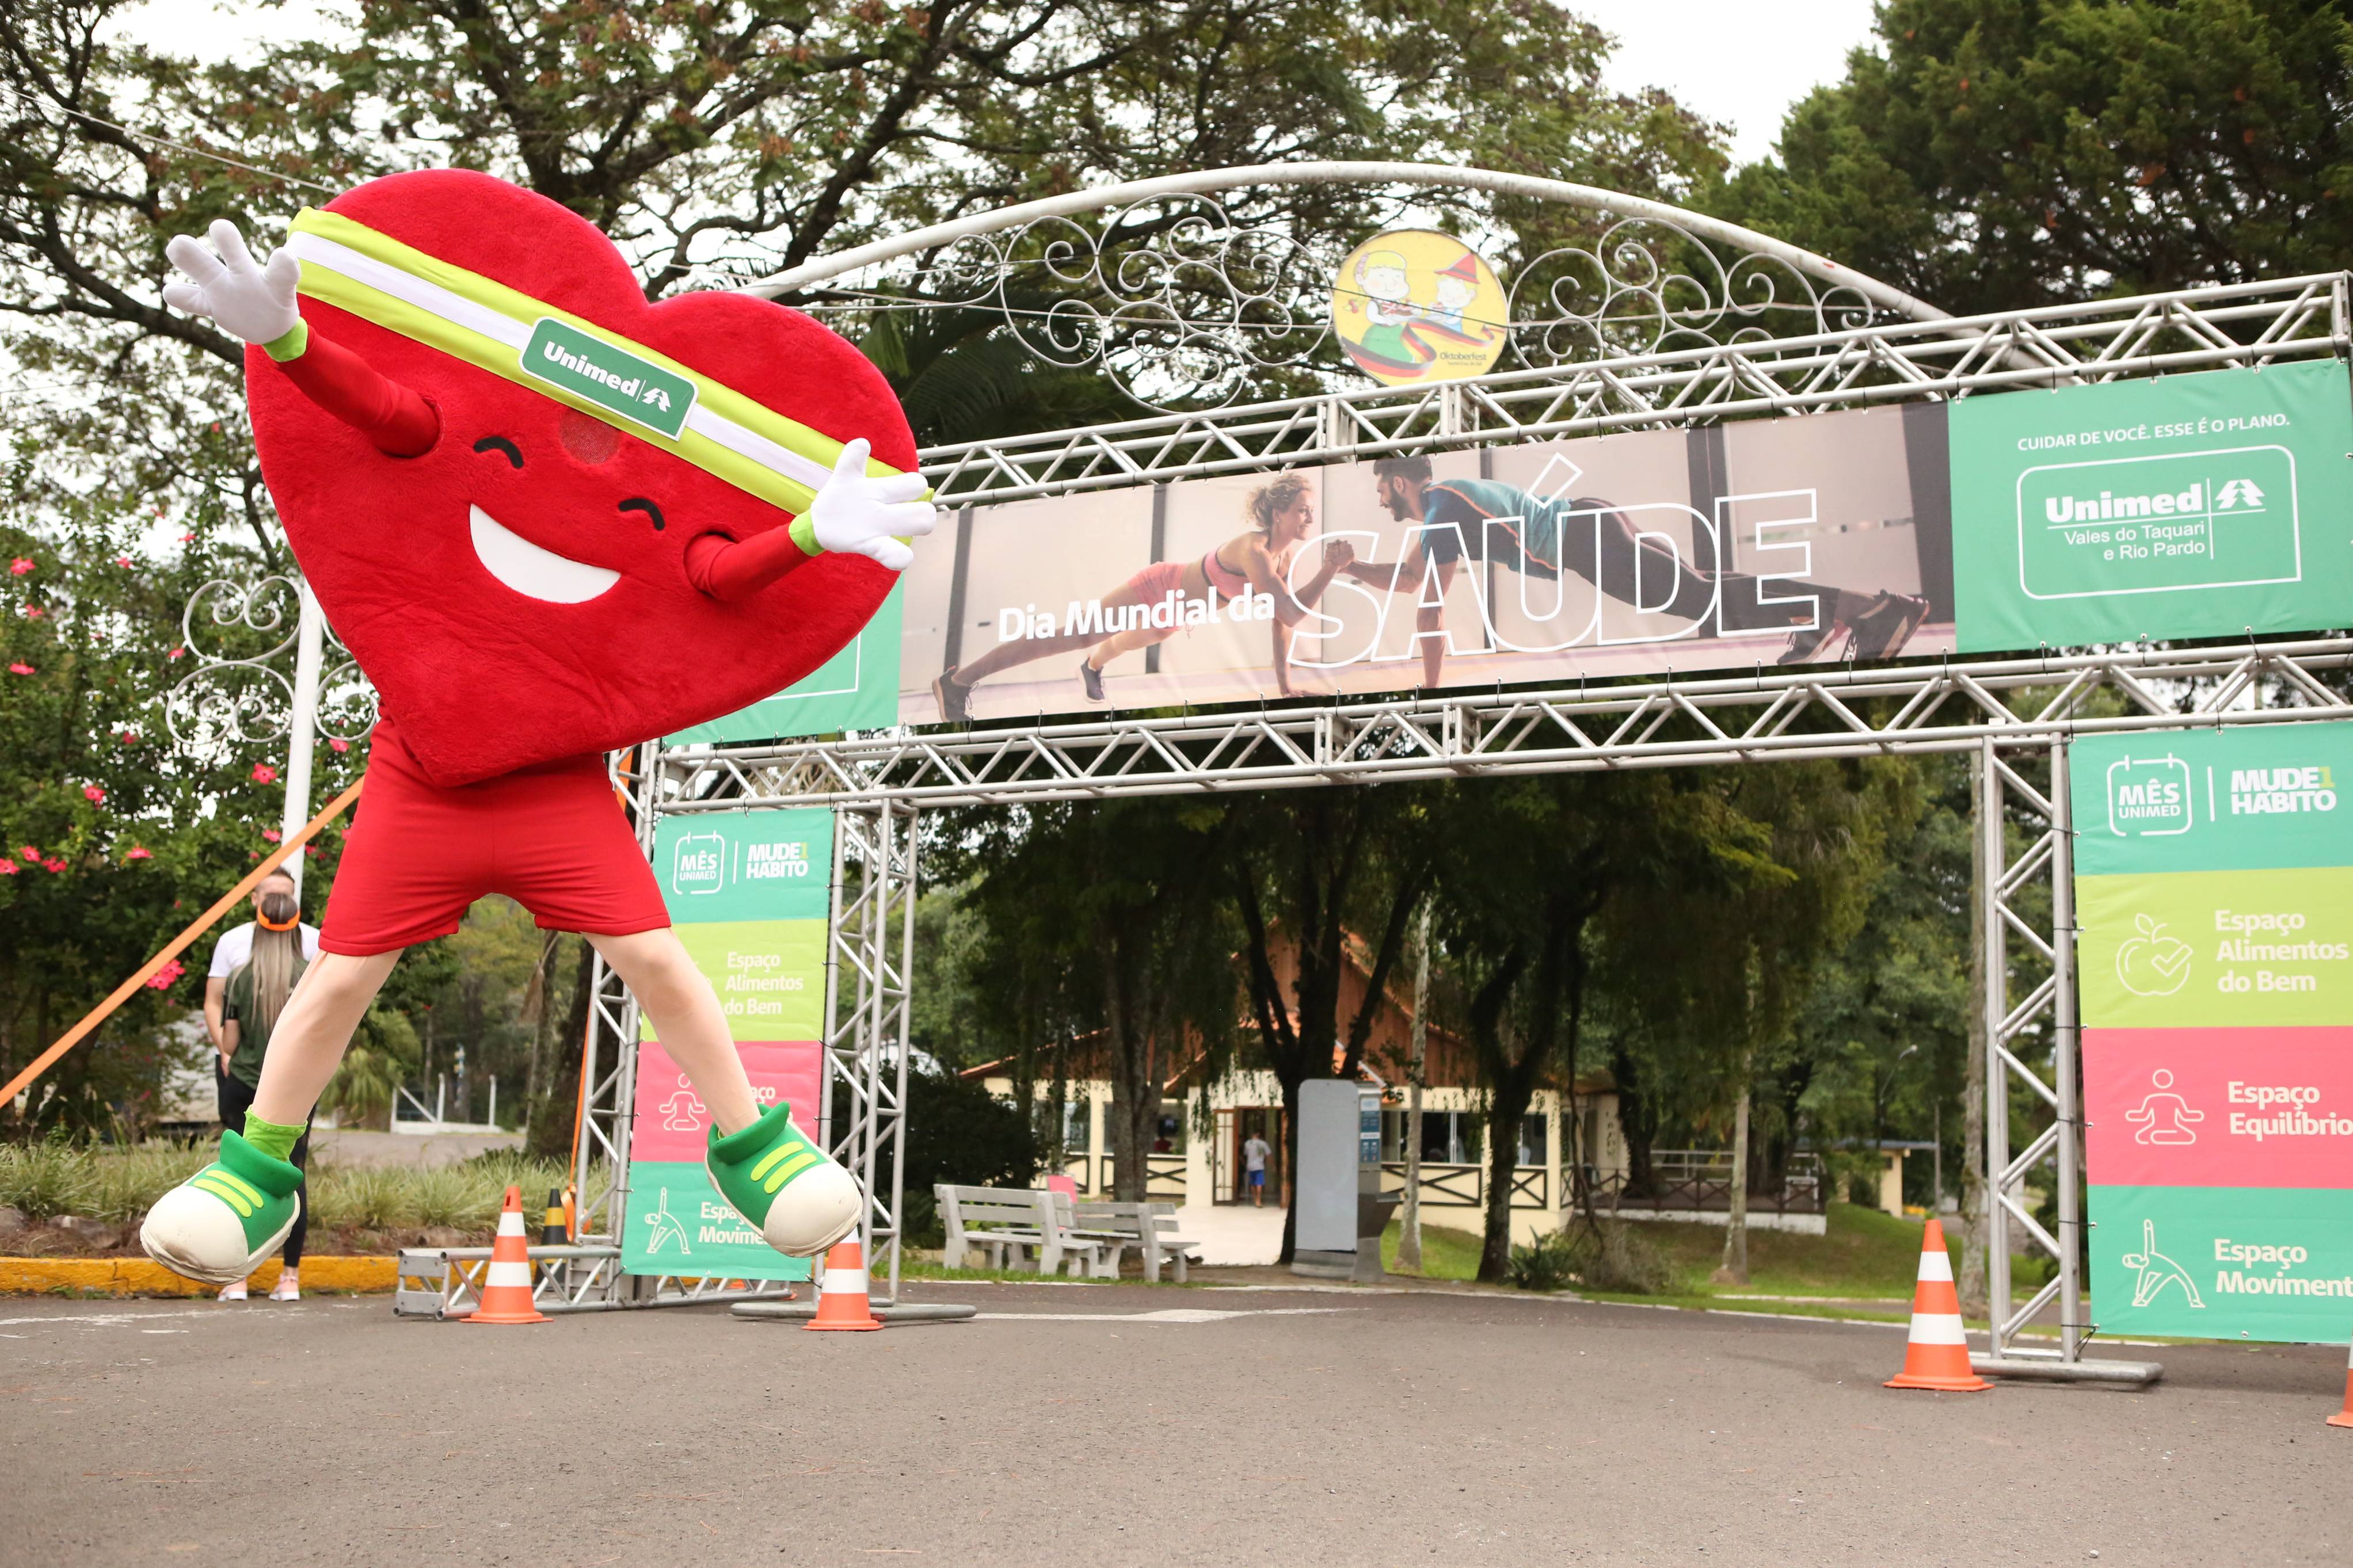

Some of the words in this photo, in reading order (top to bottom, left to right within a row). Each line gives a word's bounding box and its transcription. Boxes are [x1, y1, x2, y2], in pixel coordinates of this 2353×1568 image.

[1440, 352, 1487, 360] Oktoberfest
[543, 341, 641, 398] Unimed
[2017, 433, 2076, 451] CUIDAR
[2080, 430, 2101, 445] DE
[2104, 424, 2151, 442] VOCÊ.
[2154, 424, 2194, 438] ESSE
[2198, 417, 2207, 433] É
[2211, 419, 2224, 432] O
[2228, 413, 2290, 431] PLANO.
[2045, 483, 2203, 523] Unimed
[2064, 529, 2110, 545] Vales
[2115, 528, 2137, 542] do
[2141, 521, 2204, 542] Taquari
[999, 603, 1056, 642] Dia
[1064, 586, 1221, 636] Mundial
[1228, 582, 1275, 621] da
[1286, 452, 1819, 669] SAÚDE
[2103, 547, 2114, 560] e
[2120, 544, 2148, 559] Rio
[2153, 540, 2205, 556] Pardo
[2118, 778, 2180, 806] MÊS
[2231, 789, 2337, 815] HÁBITO
[2119, 804, 2180, 819] UNIMED
[680, 850, 717, 871] MÊS
[746, 860, 809, 879] HÁBITO
[679, 869, 716, 882] UNIMED
[2214, 909, 2305, 937] Espaço
[727, 951, 780, 973] Espaço
[2216, 940, 2350, 962] Alimentos
[725, 975, 804, 992] Alimentos
[2218, 971, 2252, 993] do
[2256, 972, 2316, 991] Bem
[724, 998, 743, 1015] do
[747, 998, 782, 1015] Bem
[2228, 1081, 2320, 1110] Espaço
[2229, 1111, 2353, 1142] Equilíbrio
[700, 1201, 745, 1225] Espa
[698, 1226, 768, 1245] Movime
[2214, 1238, 2308, 1270] Espaço
[2215, 1271, 2353, 1298] Moviment
